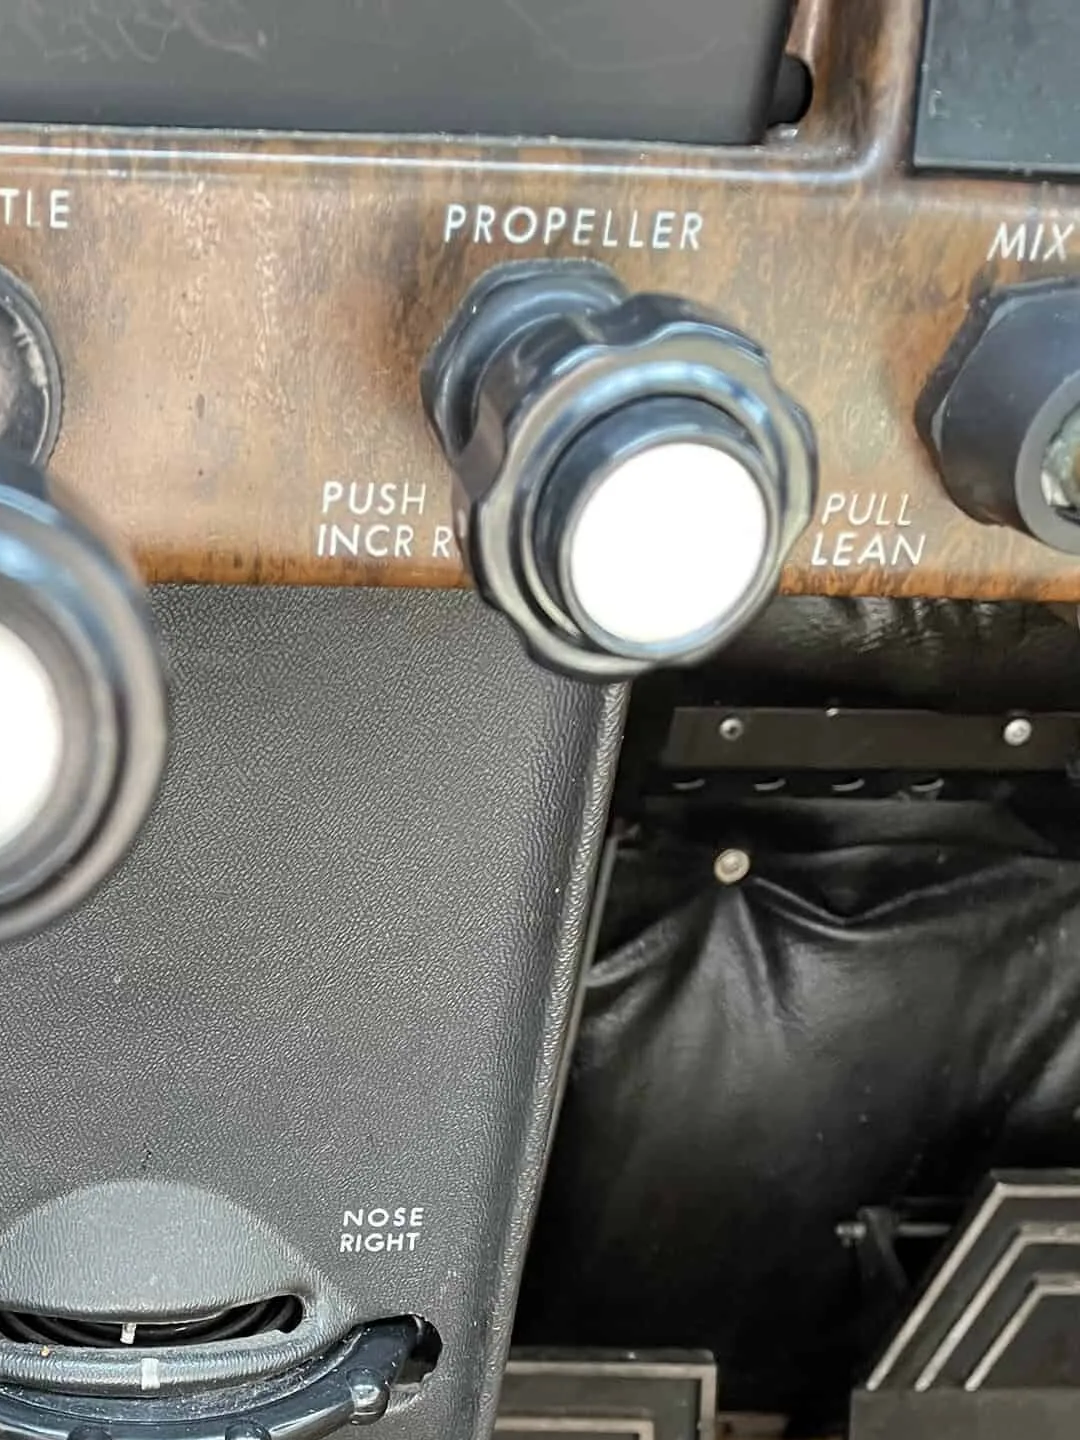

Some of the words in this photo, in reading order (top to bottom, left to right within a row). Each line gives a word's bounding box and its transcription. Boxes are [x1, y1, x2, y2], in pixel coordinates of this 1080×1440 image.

[444, 203, 703, 249] PROPELLER
[322, 480, 426, 516] PUSH
[821, 492, 911, 527] PULL
[317, 523, 414, 558] INCR
[811, 532, 926, 567] LEAN
[342, 1207, 424, 1228] NOSE
[340, 1232, 421, 1253] RIGHT
